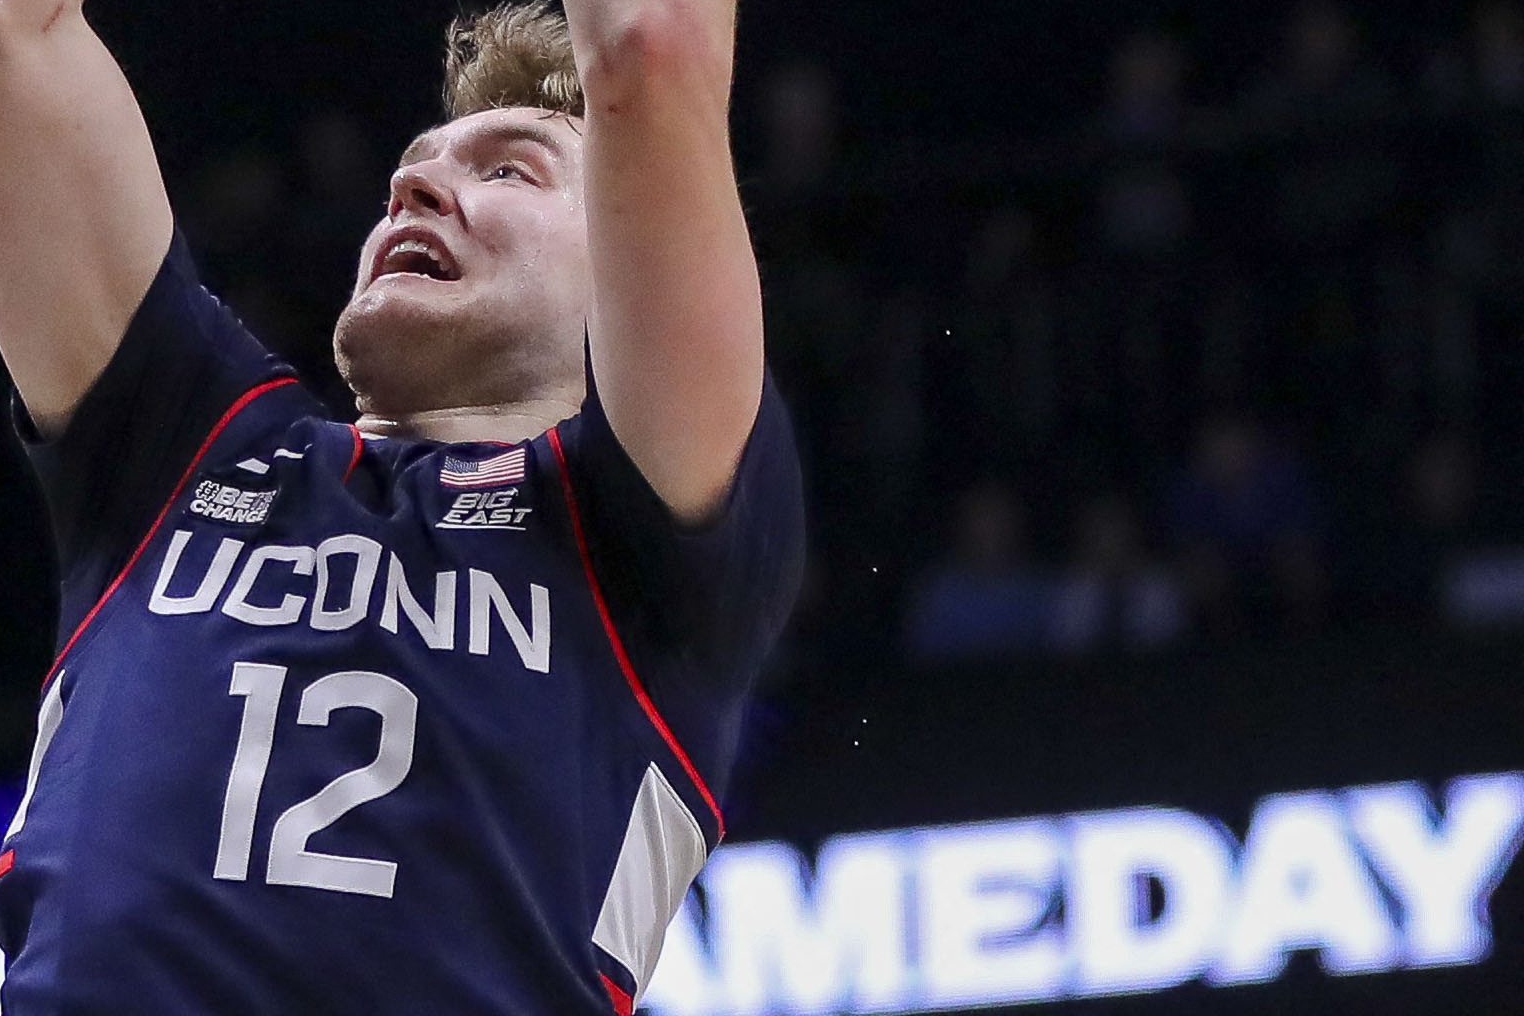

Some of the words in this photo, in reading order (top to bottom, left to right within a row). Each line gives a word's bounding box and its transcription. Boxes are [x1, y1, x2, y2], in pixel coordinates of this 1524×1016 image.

[189, 499, 269, 523] CHANGE
[452, 488, 519, 510] BIG
[443, 509, 533, 525] EAST
[147, 533, 551, 674] UCONN
[213, 661, 419, 899] 12
